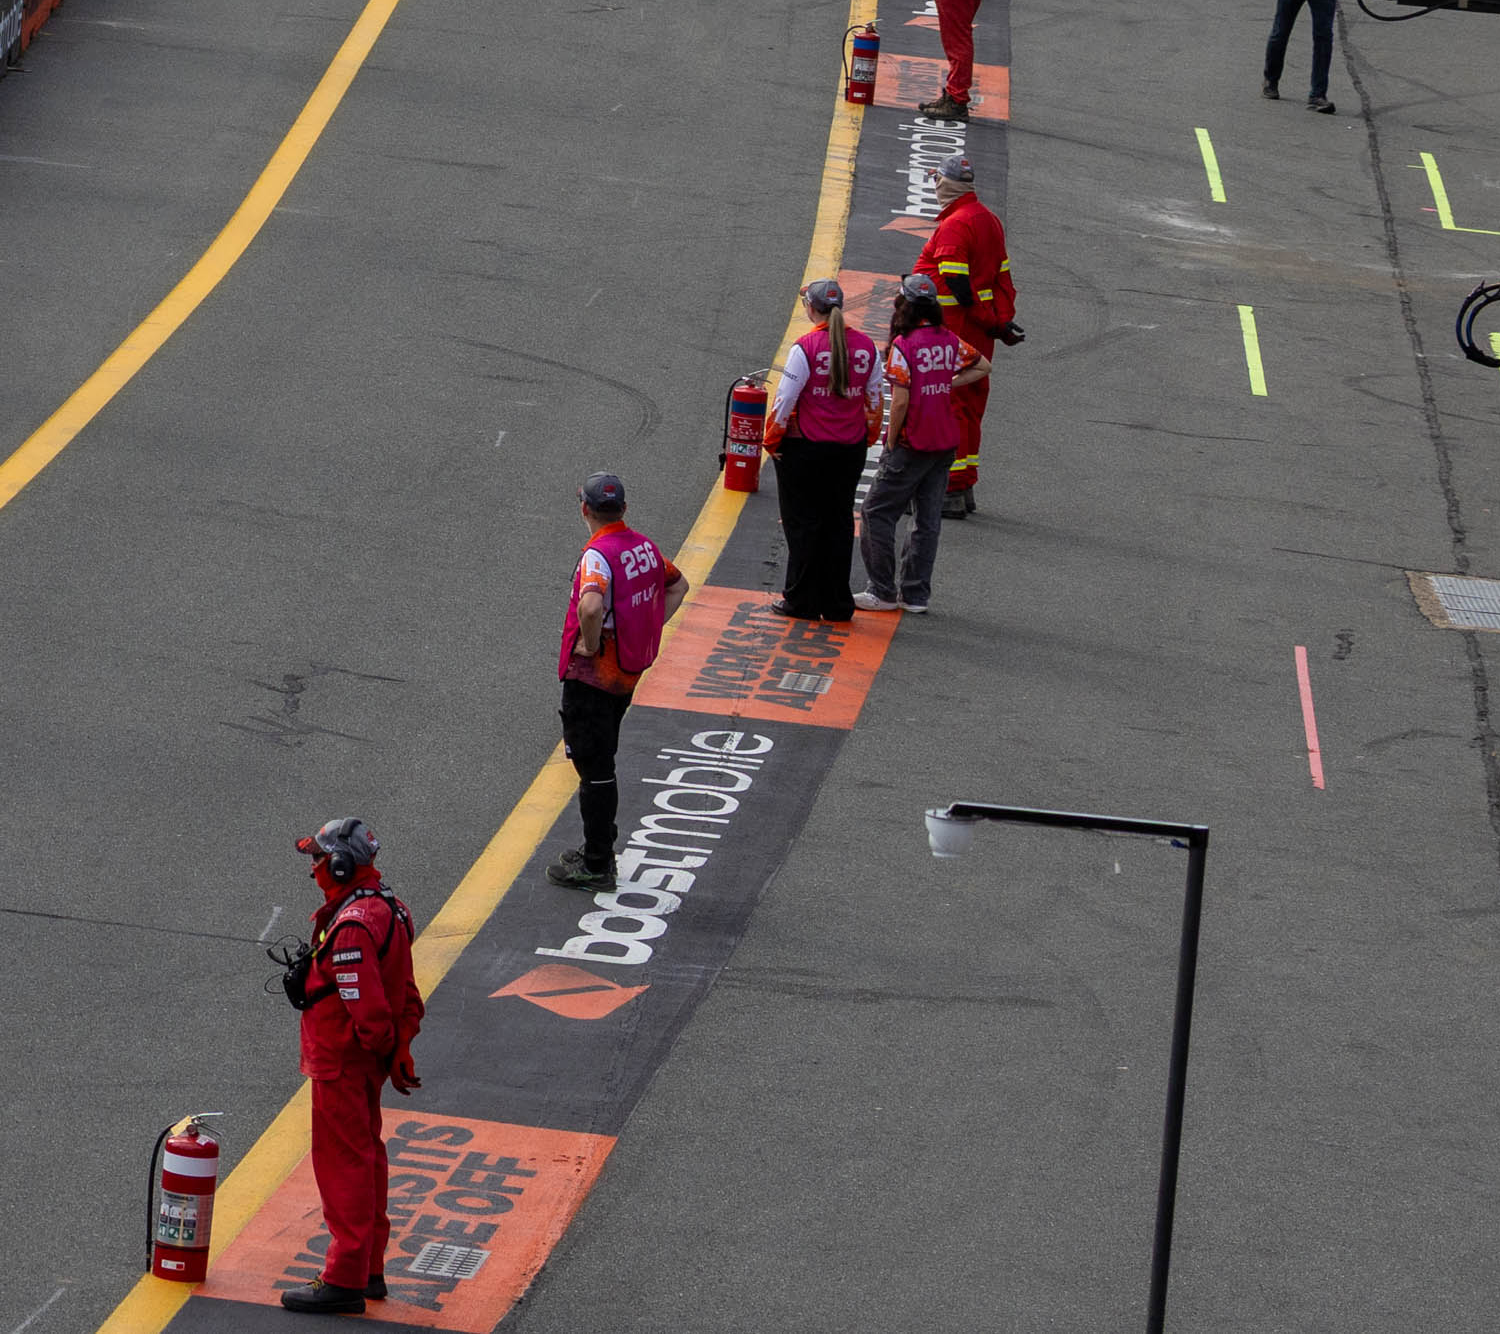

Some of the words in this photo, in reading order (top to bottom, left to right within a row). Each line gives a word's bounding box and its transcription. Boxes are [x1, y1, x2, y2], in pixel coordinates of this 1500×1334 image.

[815, 348, 871, 376] 33
[915, 344, 955, 374] 320
[535, 729, 775, 966] boostmobile
[433, 1151, 538, 1217] OFF
